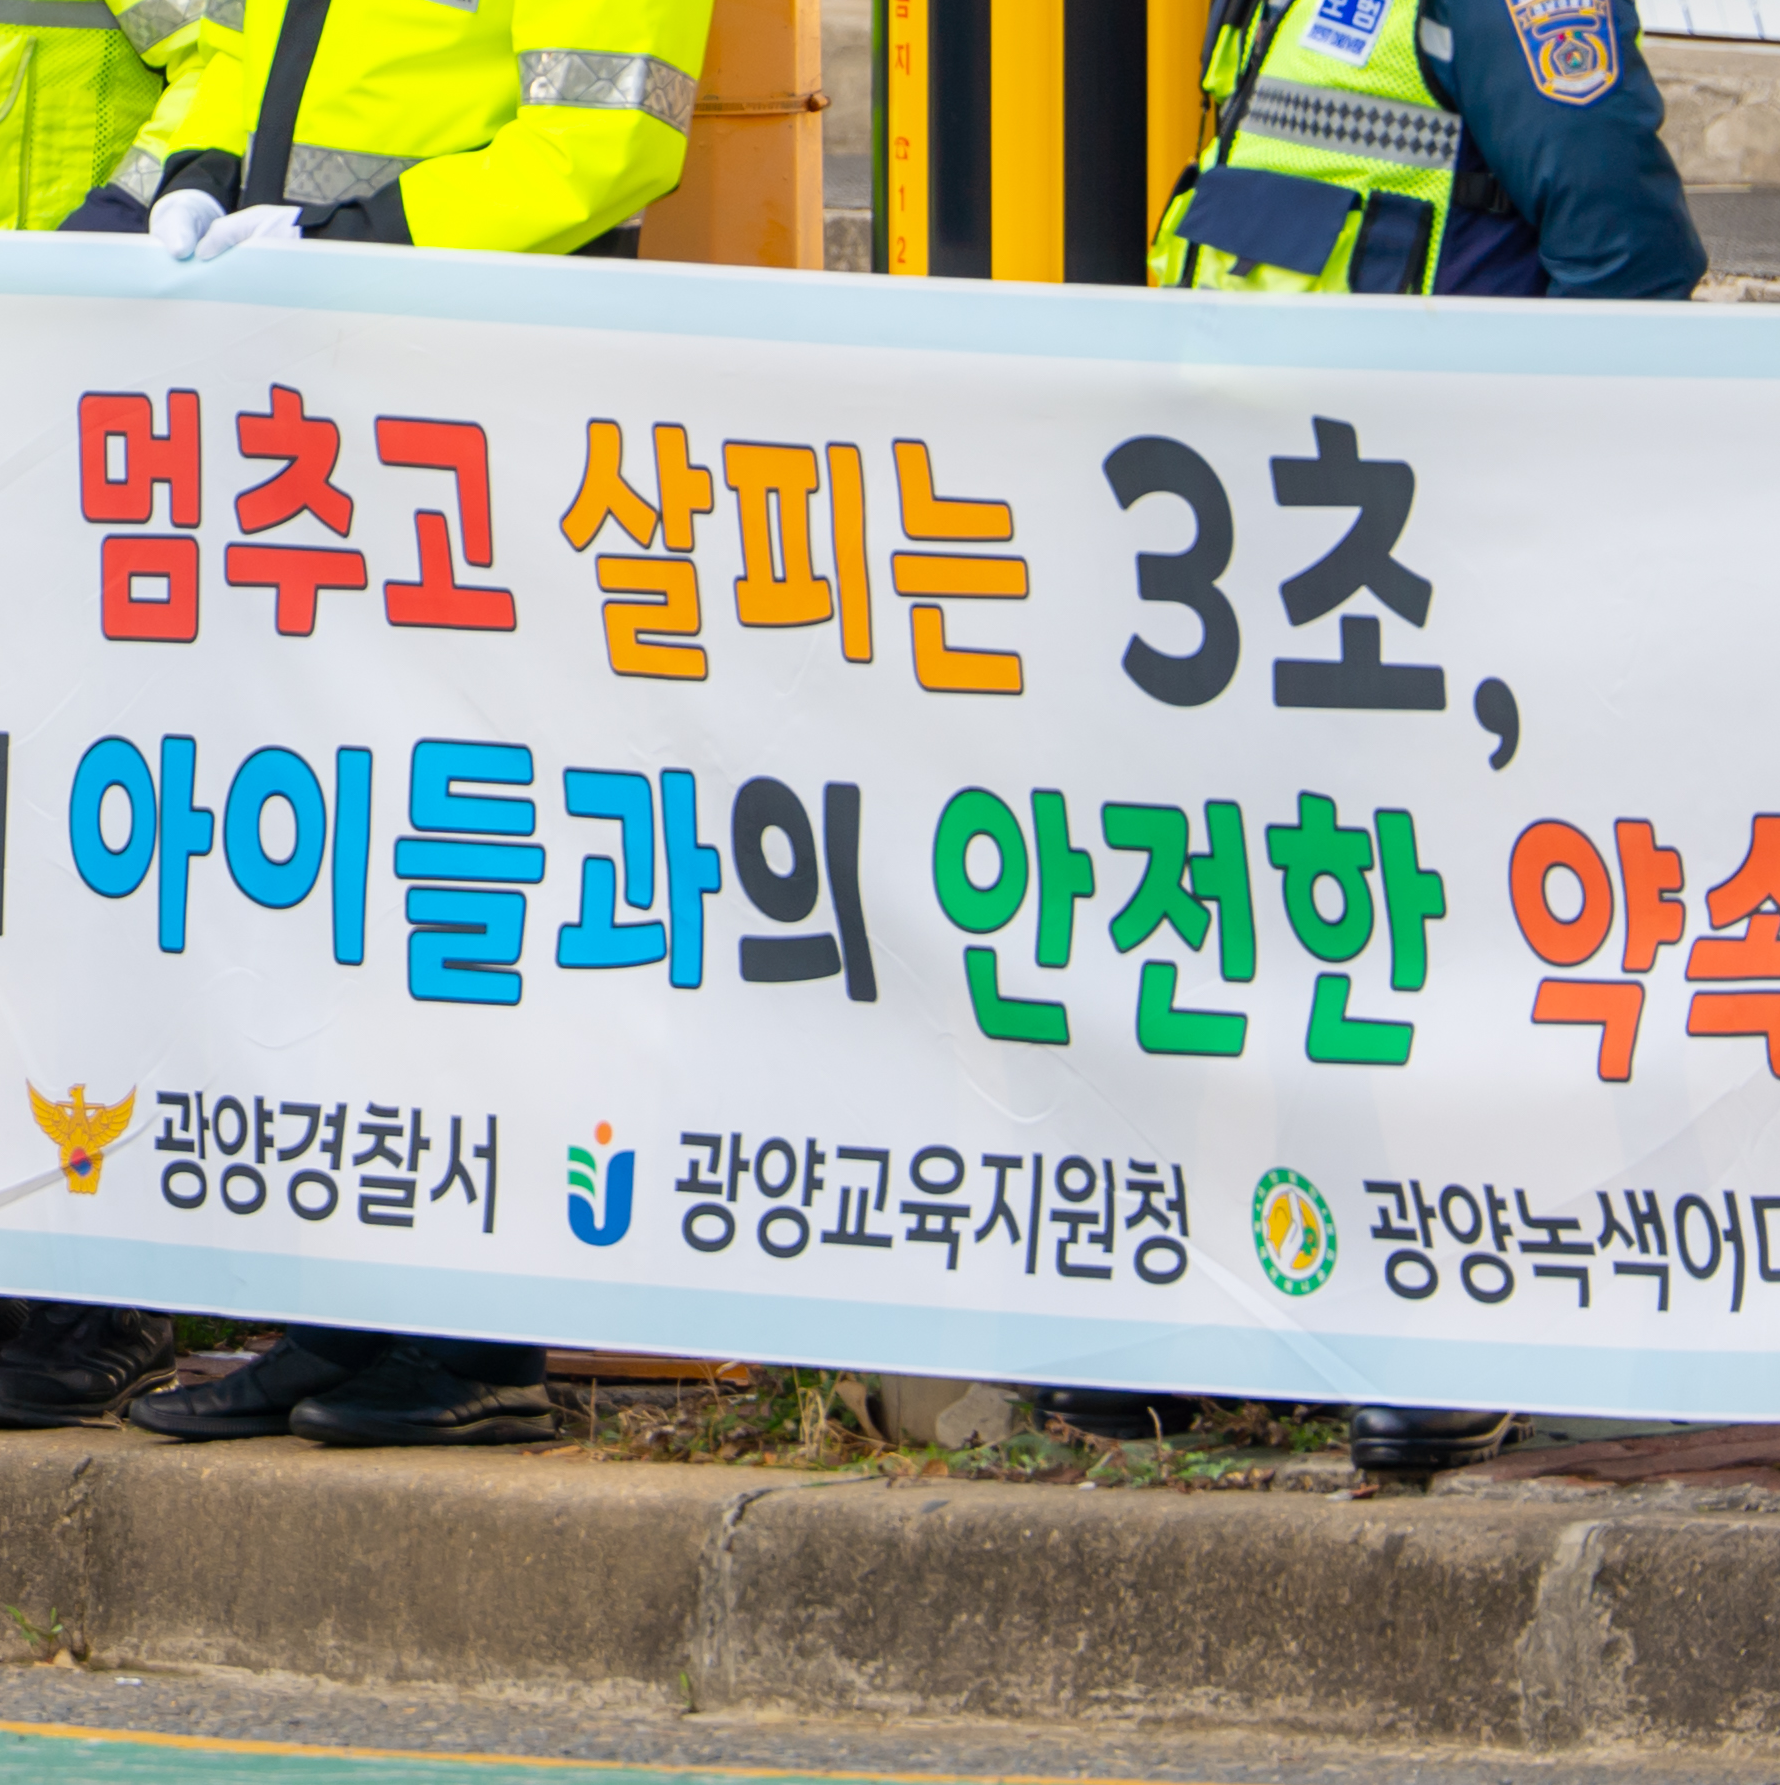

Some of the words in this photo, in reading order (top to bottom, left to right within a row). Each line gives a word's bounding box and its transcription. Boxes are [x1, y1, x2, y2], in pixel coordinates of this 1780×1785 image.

[77, 382, 518, 644] 멈추고
[559, 417, 1029, 695] 살피는
[1100, 413, 1521, 772] 3초,
[67, 734, 878, 1007] 아이들과의
[931, 784, 1447, 1066] 안전한
[153, 1088, 499, 1235] 광양경찰서
[672, 1130, 1193, 1288] 광양교육지원청
